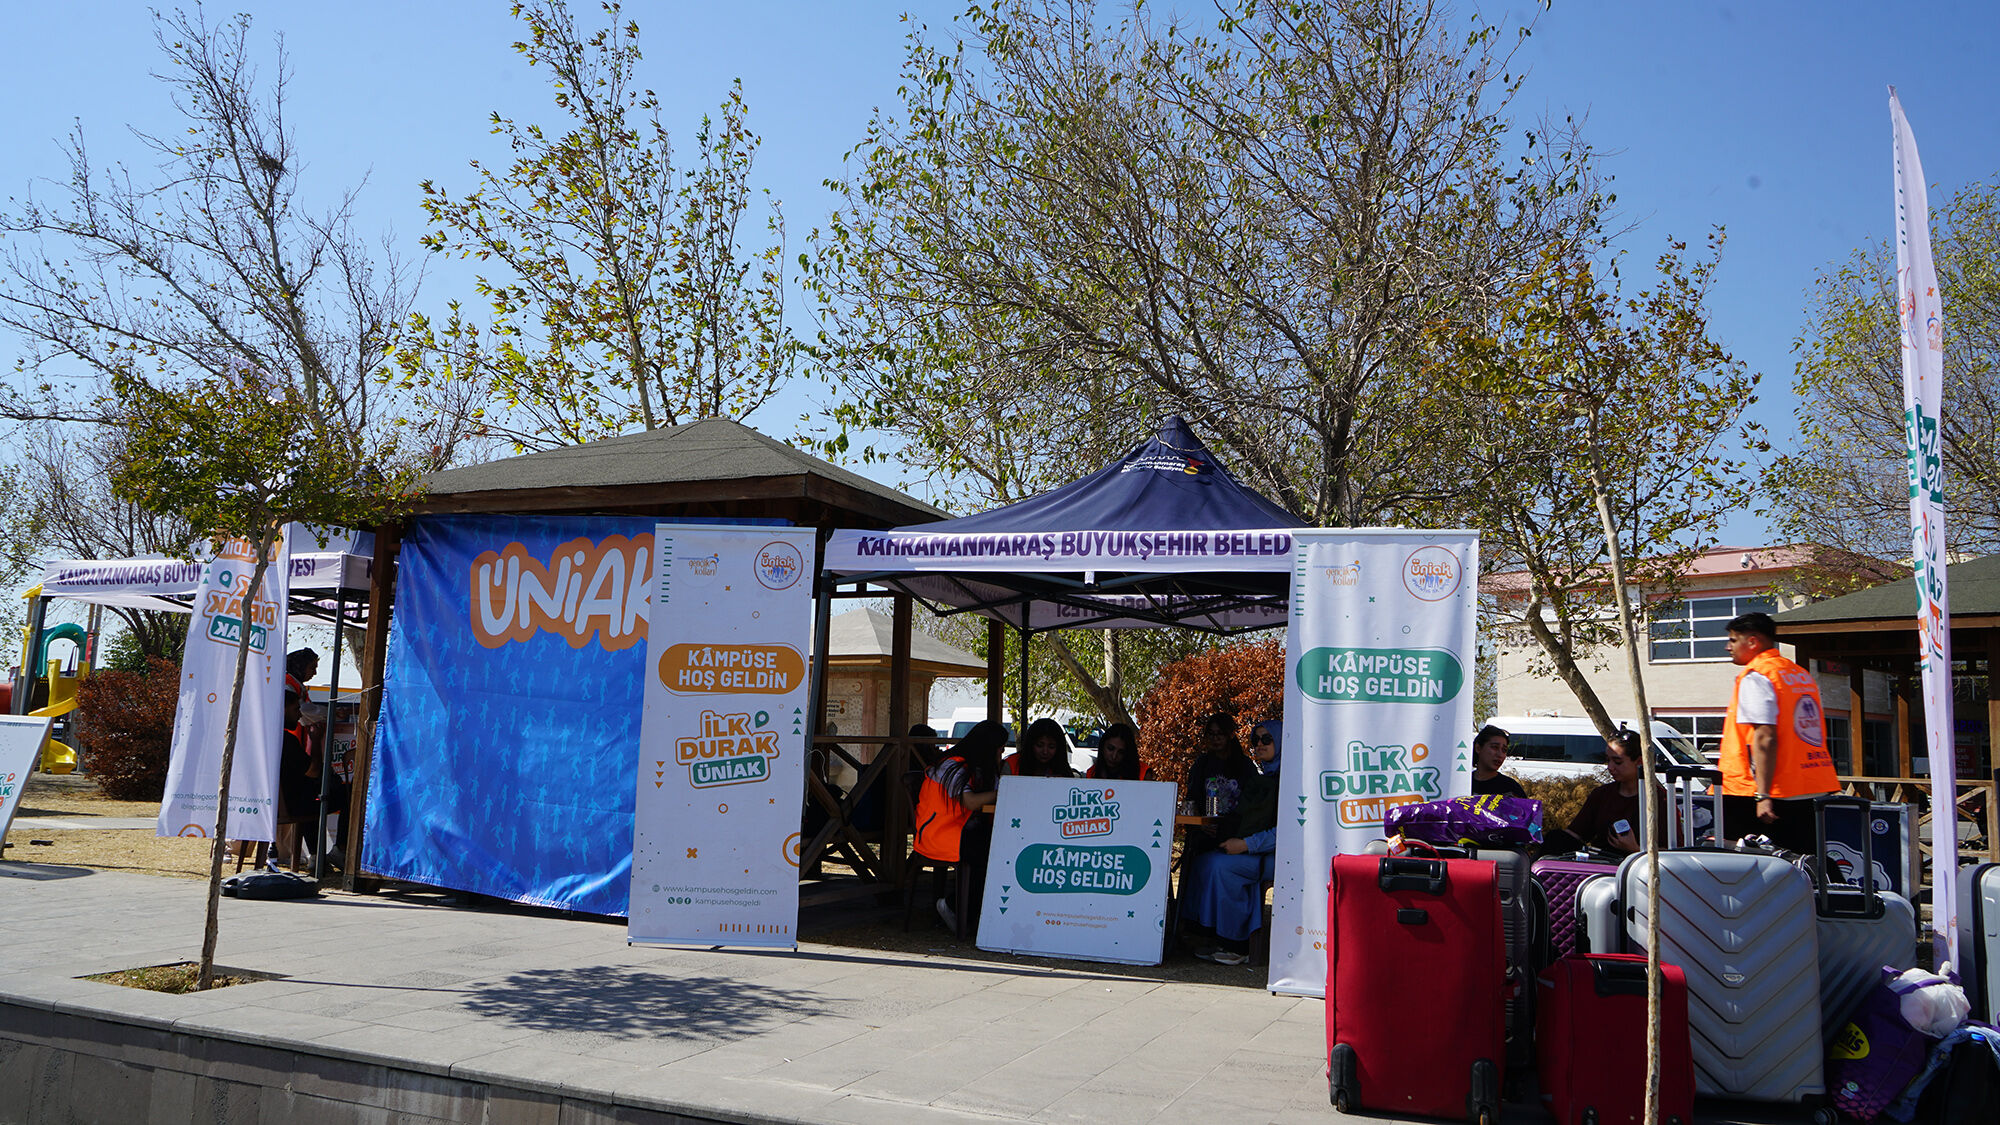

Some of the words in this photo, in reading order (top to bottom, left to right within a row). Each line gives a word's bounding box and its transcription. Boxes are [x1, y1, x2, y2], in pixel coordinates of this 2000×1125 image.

[857, 534, 1055, 560] KAHRAMANMARAŞ
[678, 669, 715, 690] HOŞ
[720, 670, 787, 688] GELDİN
[1318, 675, 1359, 698] HOŞ
[1365, 677, 1443, 698] GELDİN
[705, 715, 746, 738] İLK
[680, 736, 774, 760] DURAK
[1353, 746, 1402, 772] İLK
[697, 760, 761, 782] ÜNİAK
[1325, 772, 1435, 796] DURAK
[1071, 791, 1100, 806] İLK
[1055, 805, 1118, 820] DURAK
[1065, 821, 1107, 835] ÜNİAK
[1032, 868, 1065, 888] HOŞ
[1071, 871, 1133, 890] GELDİN
[663, 886, 777, 896] www.kampusehosgeldin.com
[695, 898, 761, 907] kampusehosgeldi
